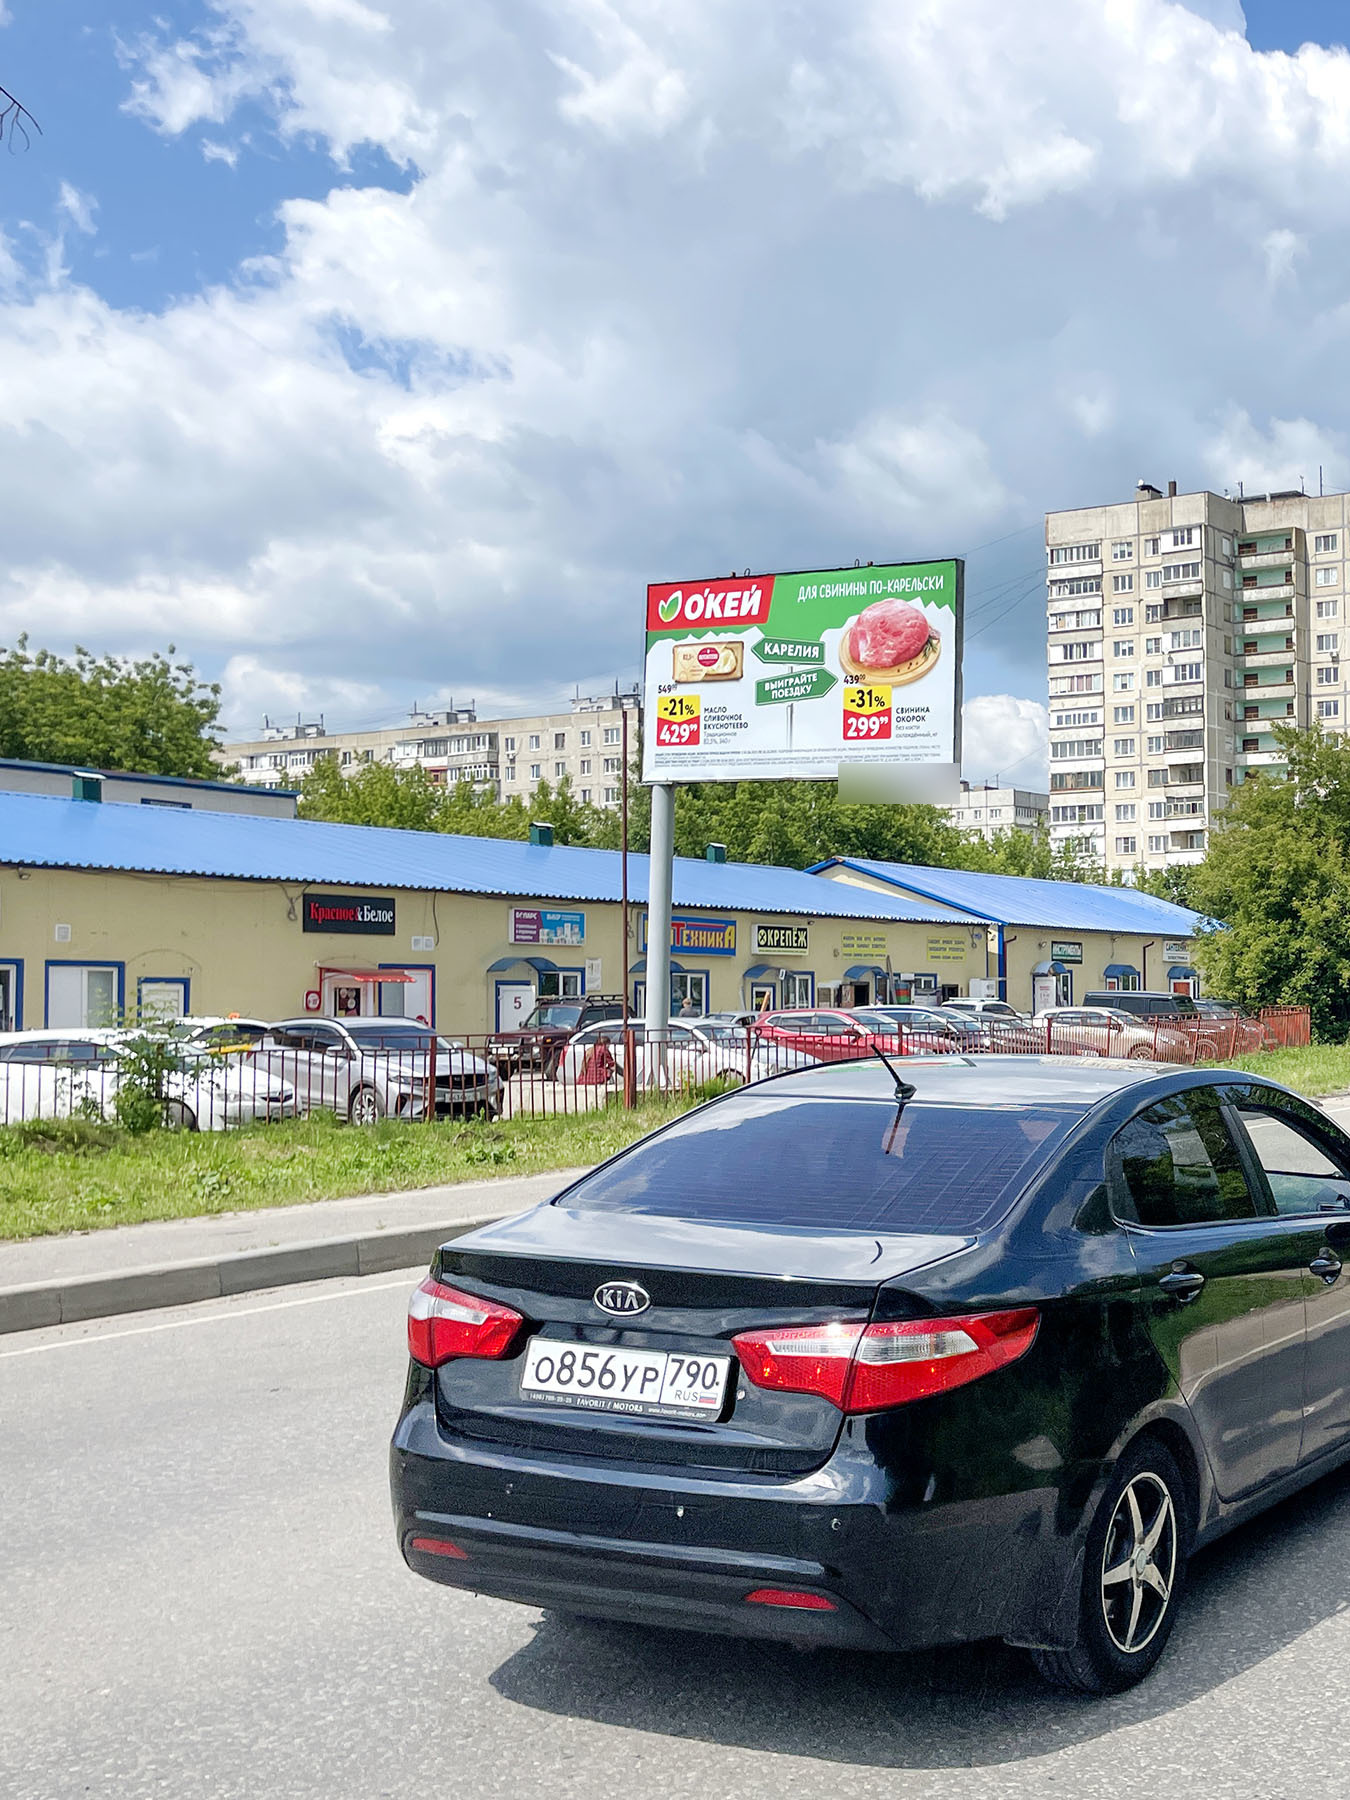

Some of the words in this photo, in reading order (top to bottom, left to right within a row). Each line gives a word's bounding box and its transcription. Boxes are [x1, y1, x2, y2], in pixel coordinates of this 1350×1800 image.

[797, 585, 817, 602] ДЛЯ
[819, 581, 867, 598] СВИНИНЫ
[869, 575, 944, 595] ПО-КАРЕЛЬСКИ
[684, 584, 762, 620] О'КЕЙ
[764, 642, 820, 659] КАРЕЛИЯ
[764, 673, 818, 691] ВЫИГРАЙТЕ
[771, 684, 812, 699] ПОЕЗДКУ
[850, 689, 885, 708] -31%
[663, 698, 695, 716] -21%
[704, 706, 727, 714] МАСЛО
[896, 706, 930, 715] СВИНИНА
[704, 714, 742, 722] СЛИВОЧНОЕ
[704, 722, 748, 730] ВКУСНОТЕЕВО
[896, 715, 926, 723] ОКОРОК
[645, 919, 735, 949] ТЕХНИКА
[767, 928, 807, 947] КРЕПЁЖ
[514, 996, 521, 1009] 5
[602, 1288, 639, 1309] KIA
[675, 1389, 698, 1402] RUS
[577, 1398, 605, 1408] FAVORIT
[612, 1401, 643, 1412] MOTORS
